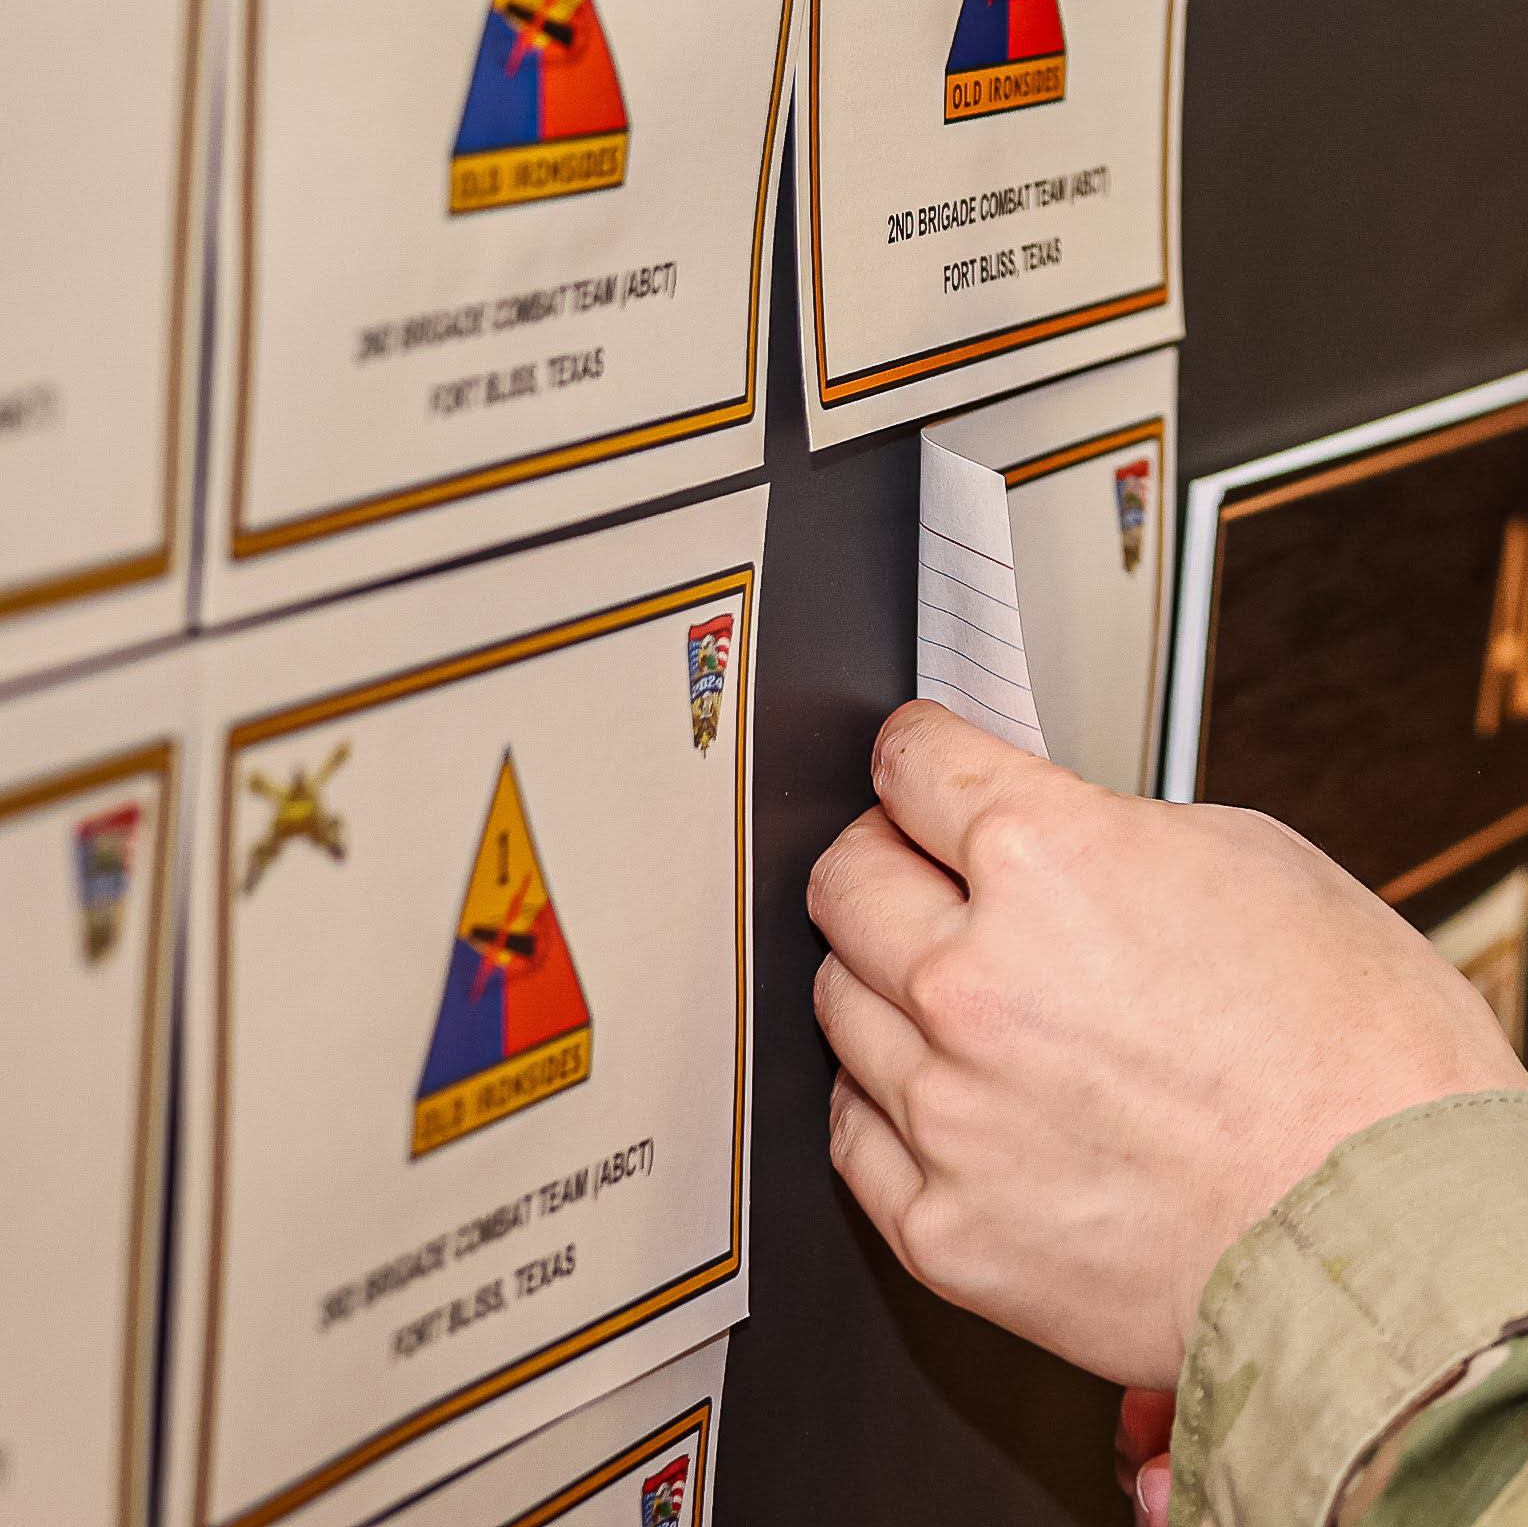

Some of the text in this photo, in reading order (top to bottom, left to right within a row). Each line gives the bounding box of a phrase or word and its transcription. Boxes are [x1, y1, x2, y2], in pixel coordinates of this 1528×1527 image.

[952, 66, 1060, 110] OLD IRONSIDES
[887, 211, 914, 244] 2ND
[918, 196, 976, 236] BRIGADE
[980, 182, 1032, 221] COMBAT
[1034, 175, 1068, 208] TEAM
[573, 273, 618, 316] TEAM
[619, 259, 677, 310] (ABCT)
[943, 236, 1063, 294] FORT BLISS, TEXAS
[537, 1165, 588, 1218] TEAM
[591, 1137, 655, 1200] (ABCT)
